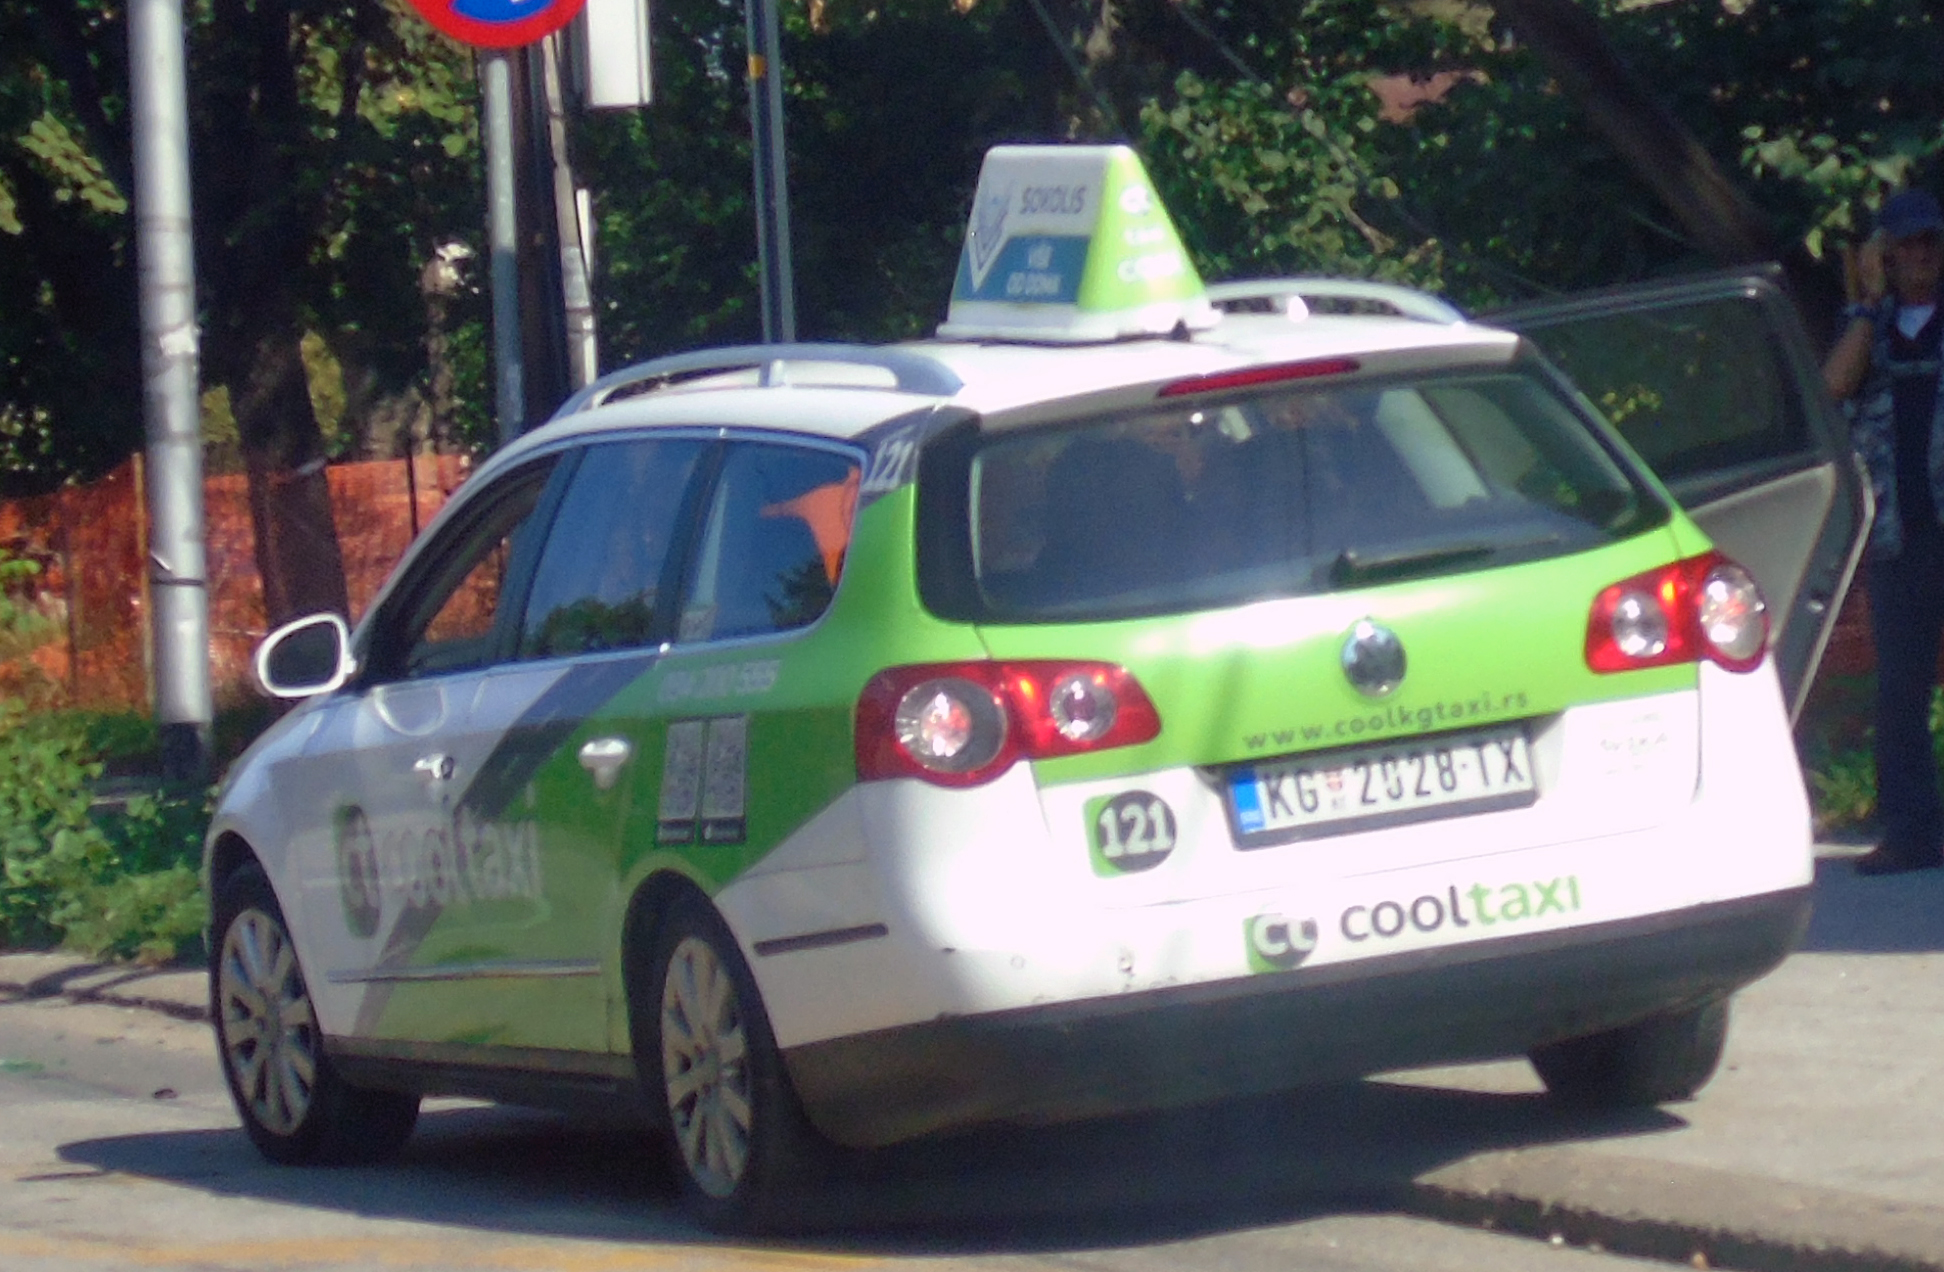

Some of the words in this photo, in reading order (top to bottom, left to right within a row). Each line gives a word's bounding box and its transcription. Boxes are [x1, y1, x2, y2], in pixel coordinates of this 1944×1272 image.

[1243, 690, 1529, 750] www.coolkgtaxi.rs
[1265, 772, 1318, 819] KG
[1100, 800, 1172, 858] 121
[1340, 875, 1581, 942] cooltaxi
